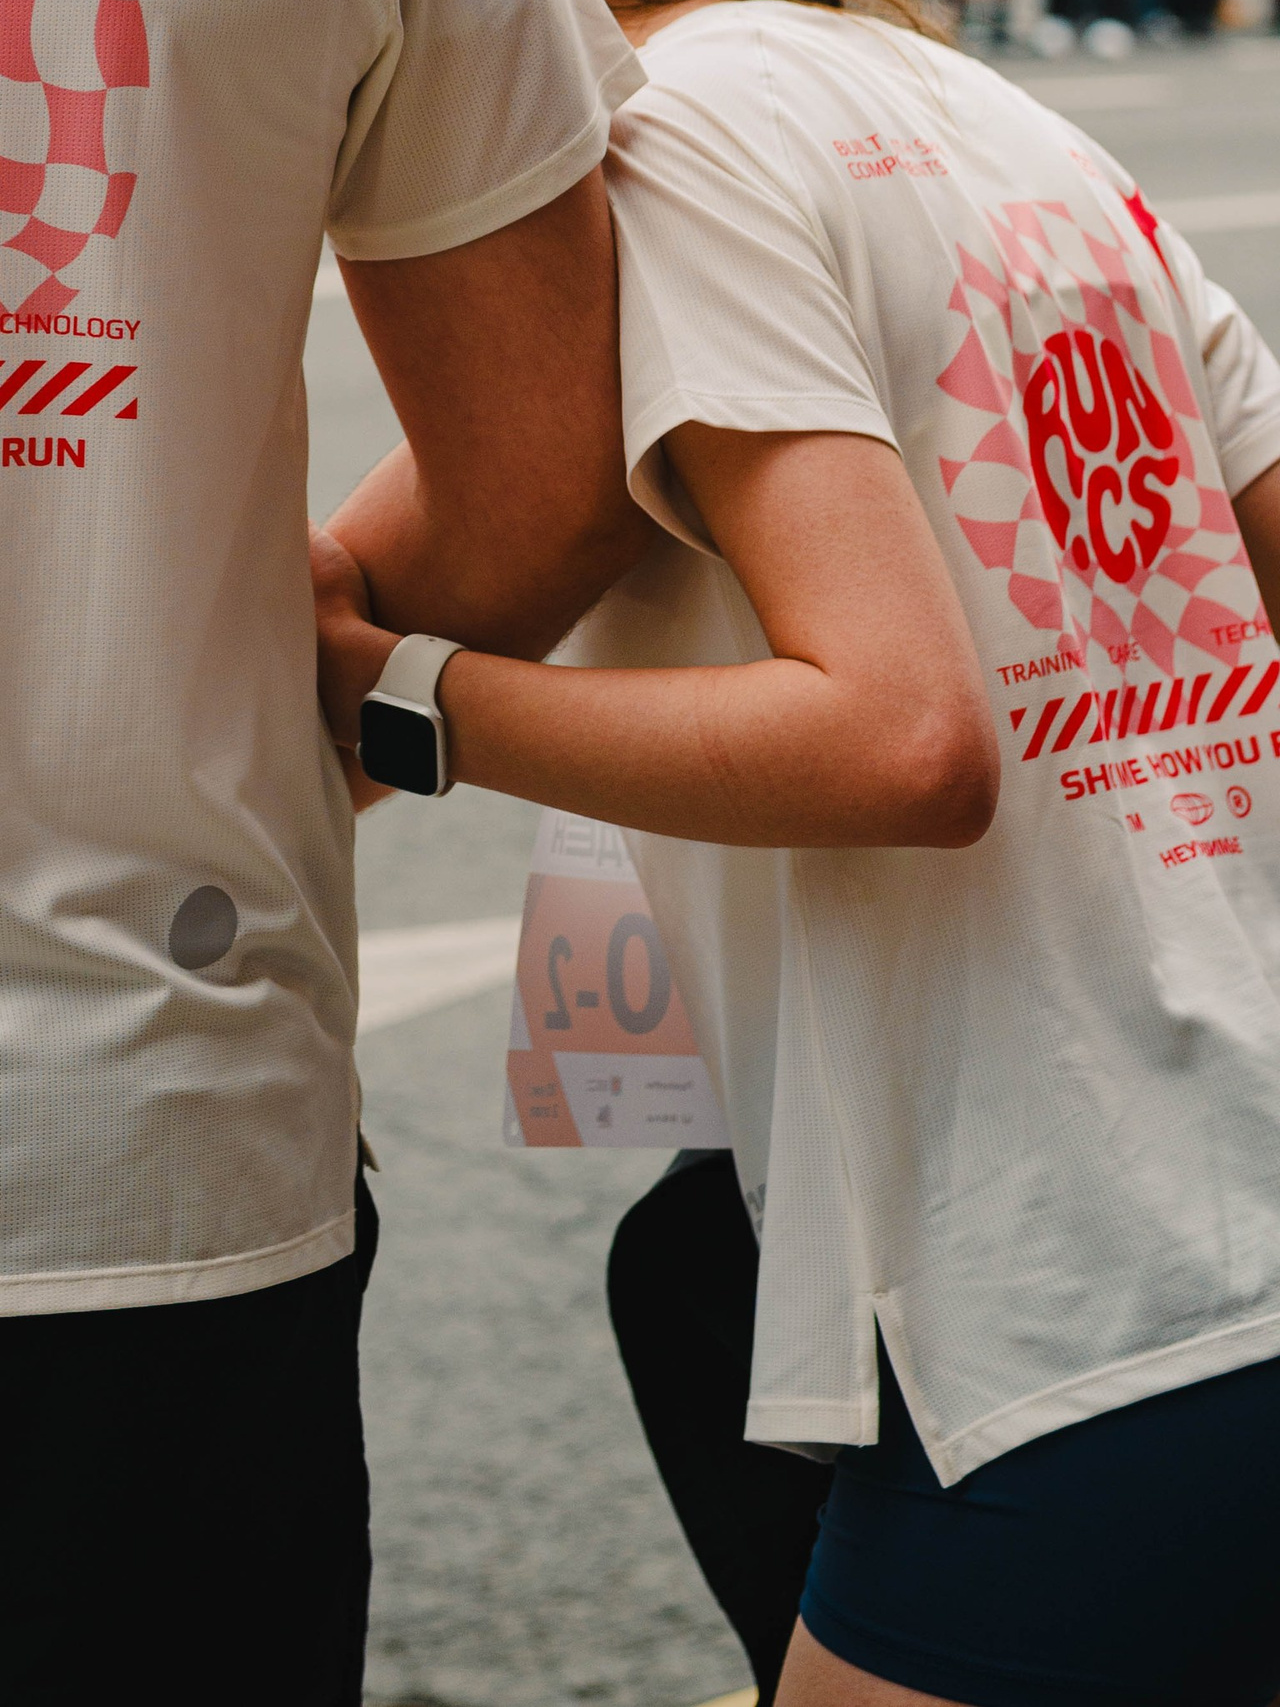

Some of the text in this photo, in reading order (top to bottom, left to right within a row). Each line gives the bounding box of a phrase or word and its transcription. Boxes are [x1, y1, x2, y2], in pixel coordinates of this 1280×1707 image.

[847, 155, 949, 180] COMPTS
[1, 436, 87, 469] RUN
[1023, 330, 1174, 551] RUN
[997, 648, 1082, 686] TRAININ
